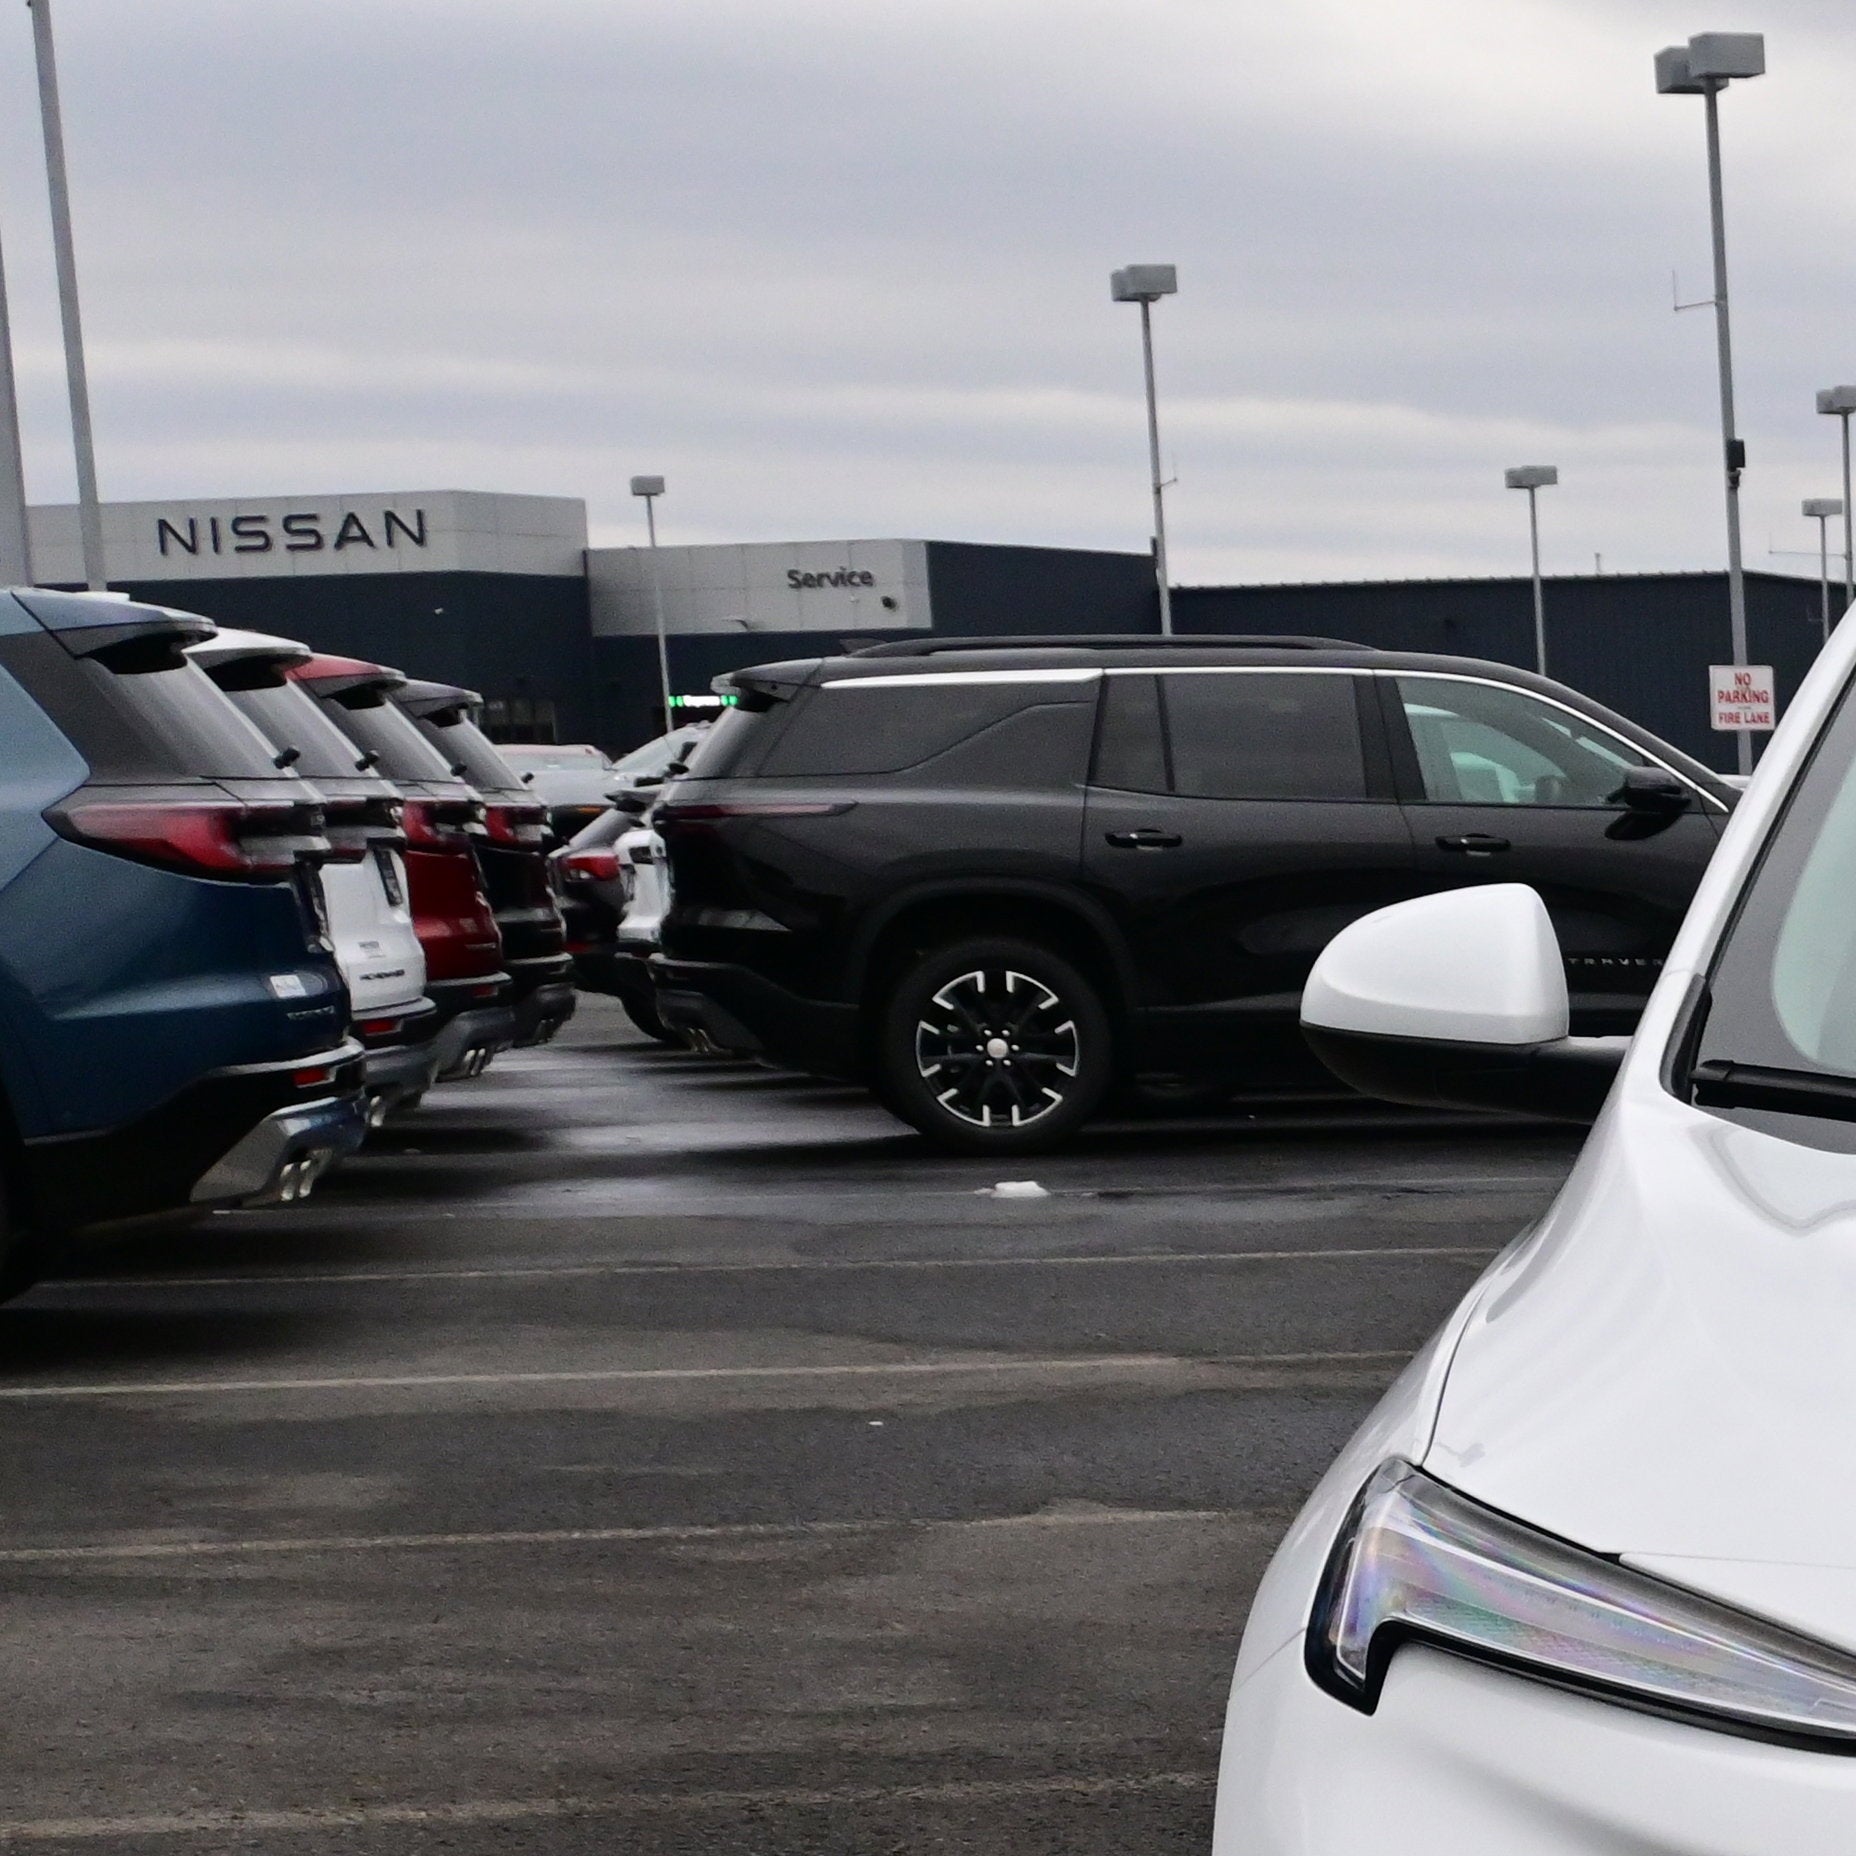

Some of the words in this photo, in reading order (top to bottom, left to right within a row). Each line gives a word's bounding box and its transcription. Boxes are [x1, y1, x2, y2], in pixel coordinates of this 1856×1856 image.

[157, 508, 427, 556] NISSAN
[787, 566, 874, 589] Service
[1734, 672, 1751, 686] NO
[1717, 690, 1769, 703] PARKING
[1718, 712, 1741, 724] FIRE
[1744, 712, 1770, 724] LANE
